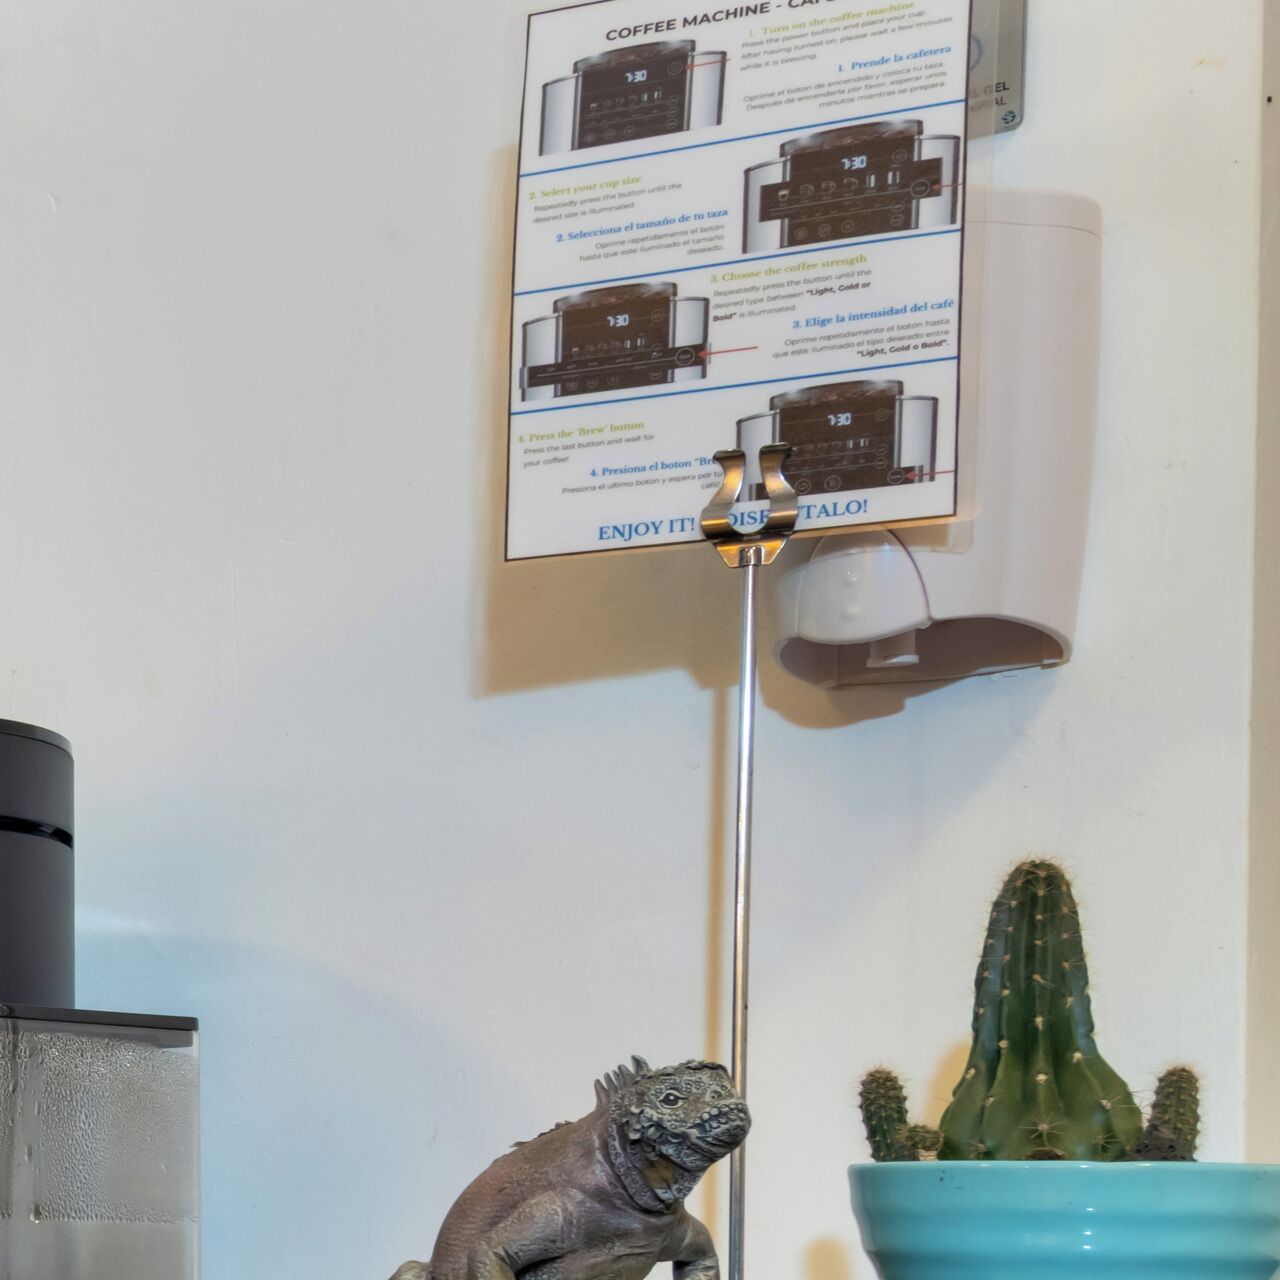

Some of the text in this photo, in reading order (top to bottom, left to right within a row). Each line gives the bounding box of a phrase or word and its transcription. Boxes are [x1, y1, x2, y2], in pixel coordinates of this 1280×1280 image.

[606, 1, 770, 41] COFFEE MACHINE
[762, 26, 789, 35] Turn
[810, 18, 826, 26] the
[829, 12, 862, 22] coffee
[867, 3, 915, 15] machine
[851, 57, 891, 69] Prende
[906, 46, 951, 59] cafetera
[534, 200, 577, 212] Repeatedly
[580, 197, 600, 206] press
[618, 190, 645, 198] button
[648, 185, 665, 193] until
[540, 176, 641, 198] Select your cup size
[568, 209, 728, 240] Selecciona el tamaño de tu taza
[595, 240, 626, 249] Oprime
[628, 230, 688, 244] repetidamente
[640, 242, 680, 252] iluminado
[722, 253, 867, 282] Choose the coffee strength
[713, 286, 759, 297] Repeatedly
[762, 283, 784, 291] press
[803, 276, 832, 284] button
[835, 271, 855, 279] until
[713, 299, 744, 309] desired
[746, 298, 764, 306] type
[767, 292, 804, 301] between
[838, 283, 859, 291] Gold
[805, 317, 832, 327] Elige
[836, 314, 845, 322] la
[848, 305, 906, 321] intensidad
[909, 302, 927, 312] del
[930, 299, 953, 310] café
[784, 337, 817, 346] Oprime
[819, 327, 884, 341] repetidamente
[925, 318, 949, 327] hasta
[811, 342, 854, 352] iluminado
[885, 333, 923, 343] deseado
[889, 344, 910, 353] Gold
[529, 422, 644, 441] Press the button
[607, 437, 622, 445] and
[602, 465, 646, 476] Presiona
[649, 462, 658, 470] el
[661, 459, 691, 469] boton
[562, 486, 596, 494] Presiona
[598, 516, 665, 541] ENJOY
[669, 517, 694, 532] IT!
